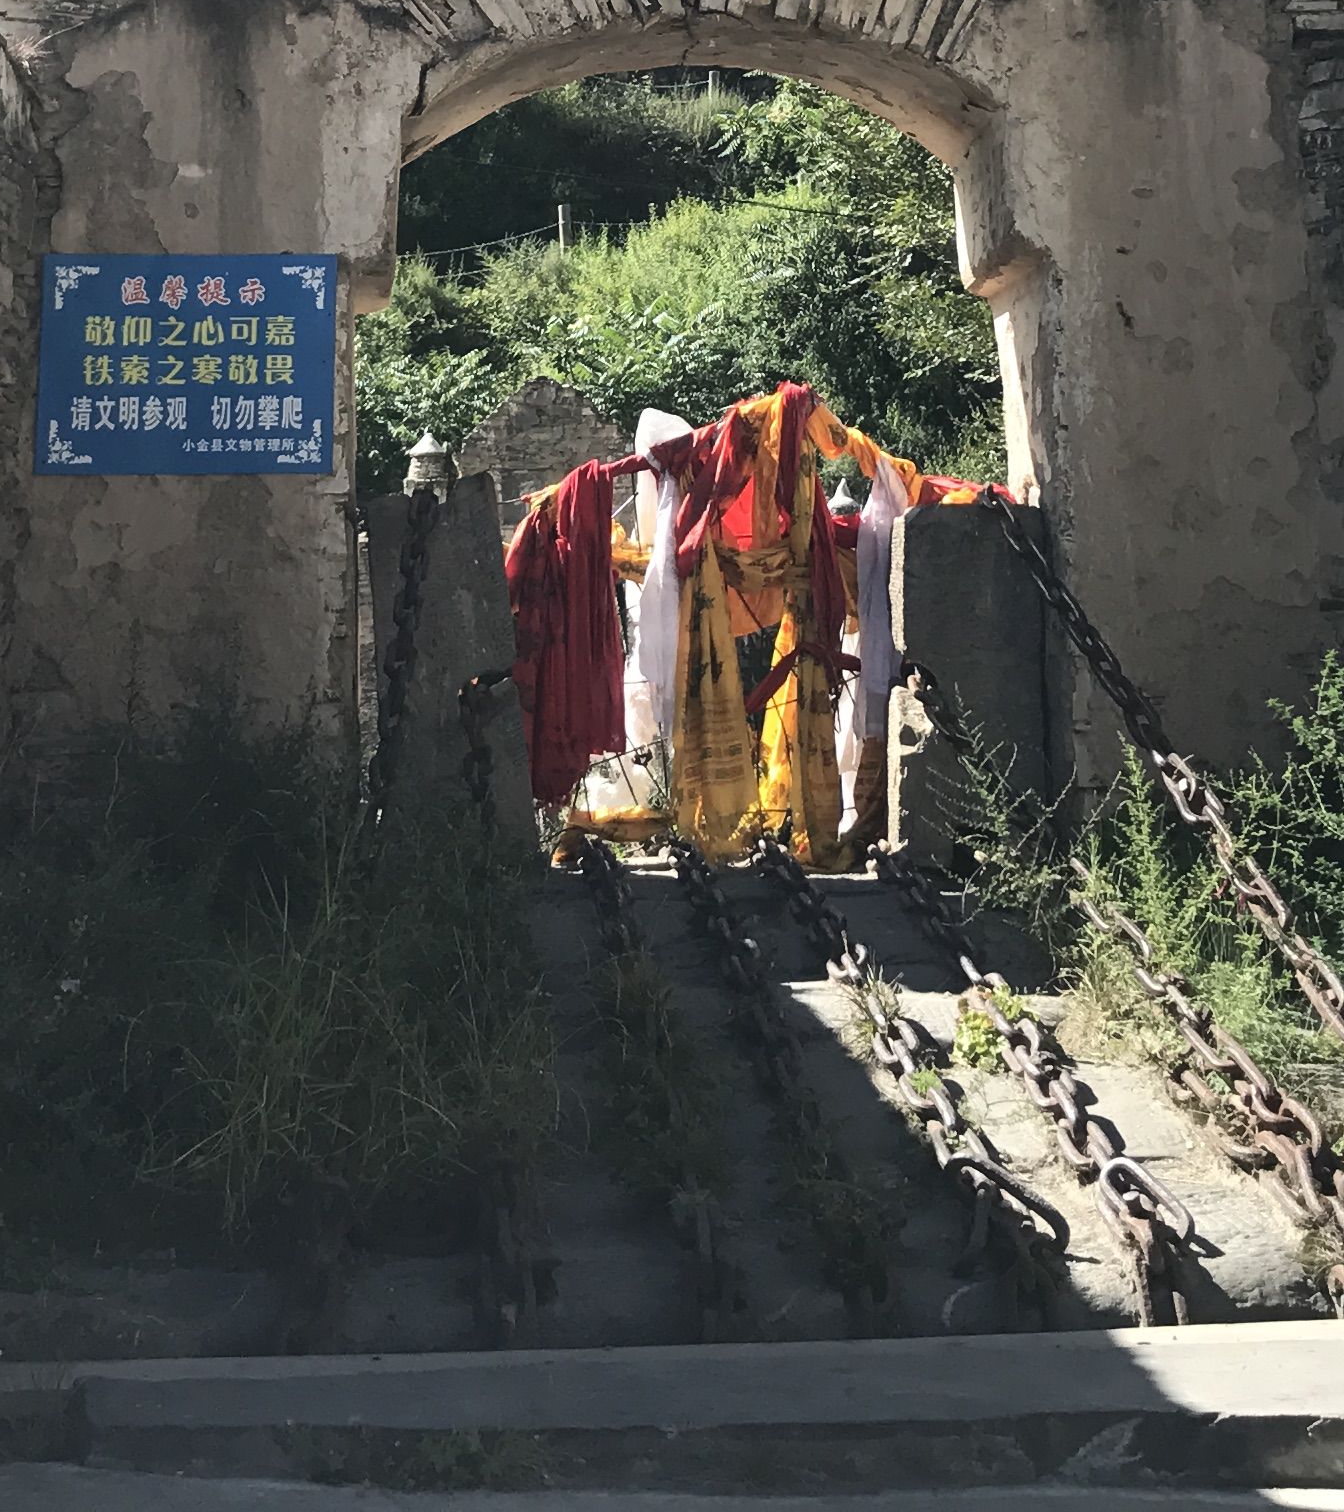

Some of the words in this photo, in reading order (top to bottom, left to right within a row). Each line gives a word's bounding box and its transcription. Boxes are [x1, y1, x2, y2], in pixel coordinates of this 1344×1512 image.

[122, 275, 266, 309] 温馨提示
[83, 315, 295, 346] 敬仰之心可嘉
[82, 354, 295, 385] 铁索之寒敬畏
[71, 396, 188, 431] 请文明参观
[211, 395, 303, 430] 切勿攀爬
[182, 438, 295, 452] 小金县文物管理所
